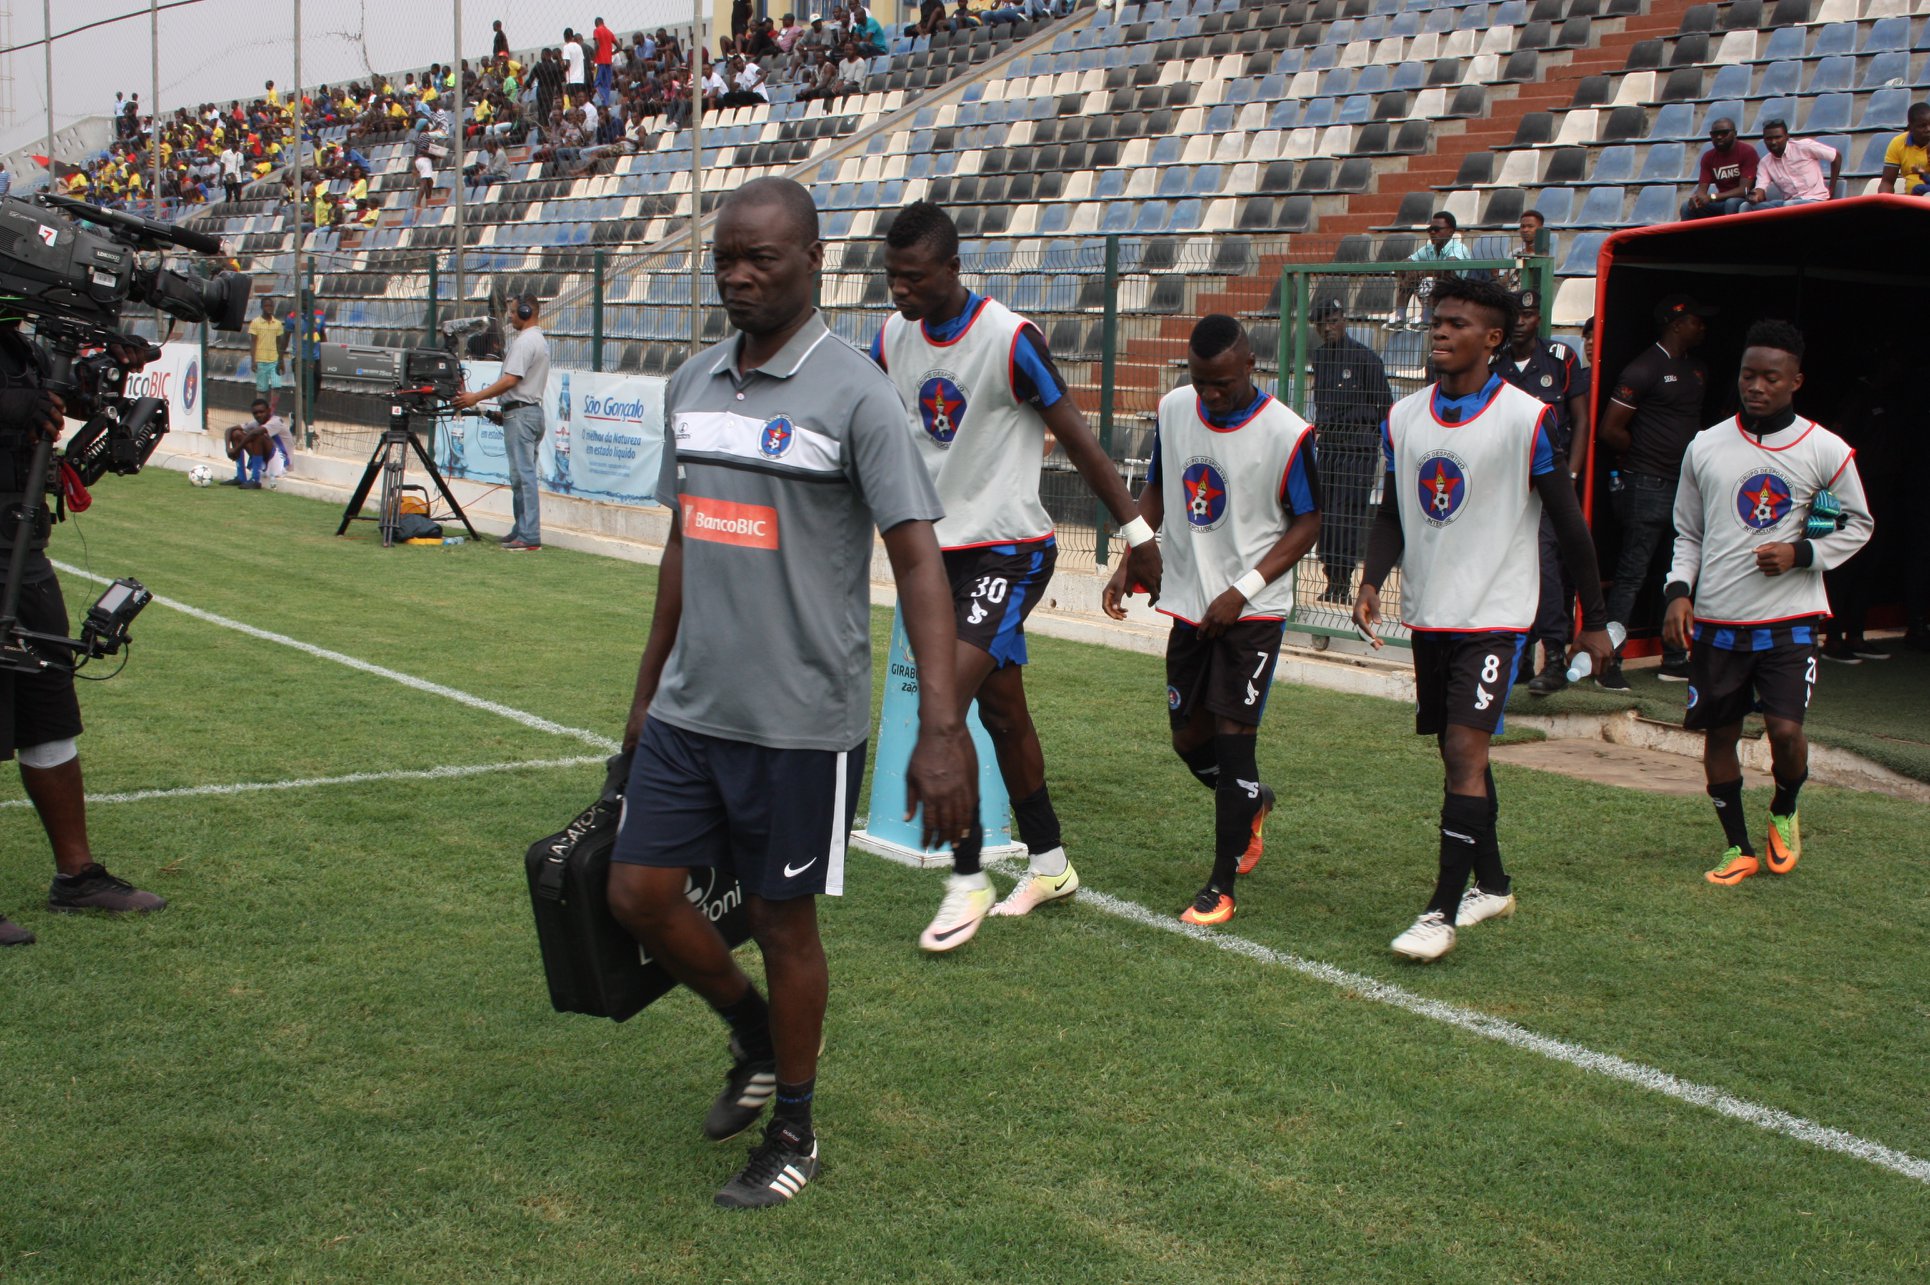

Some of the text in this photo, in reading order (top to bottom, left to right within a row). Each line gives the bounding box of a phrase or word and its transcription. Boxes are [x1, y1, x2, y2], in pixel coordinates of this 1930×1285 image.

[1713, 164, 1740, 180] VANS
[43, 229, 54, 242] 7
[127, 371, 171, 398] ncoBIC
[584, 395, 644, 422] São Gonçalo
[613, 433, 642, 446] Natureza
[1740, 468, 1794, 489] GRUPO DESPORTIVO
[695, 512, 766, 537] BancoBIC
[970, 576, 1008, 604] 30
[1252, 651, 1269, 679] 7
[1481, 654, 1500, 683] 8
